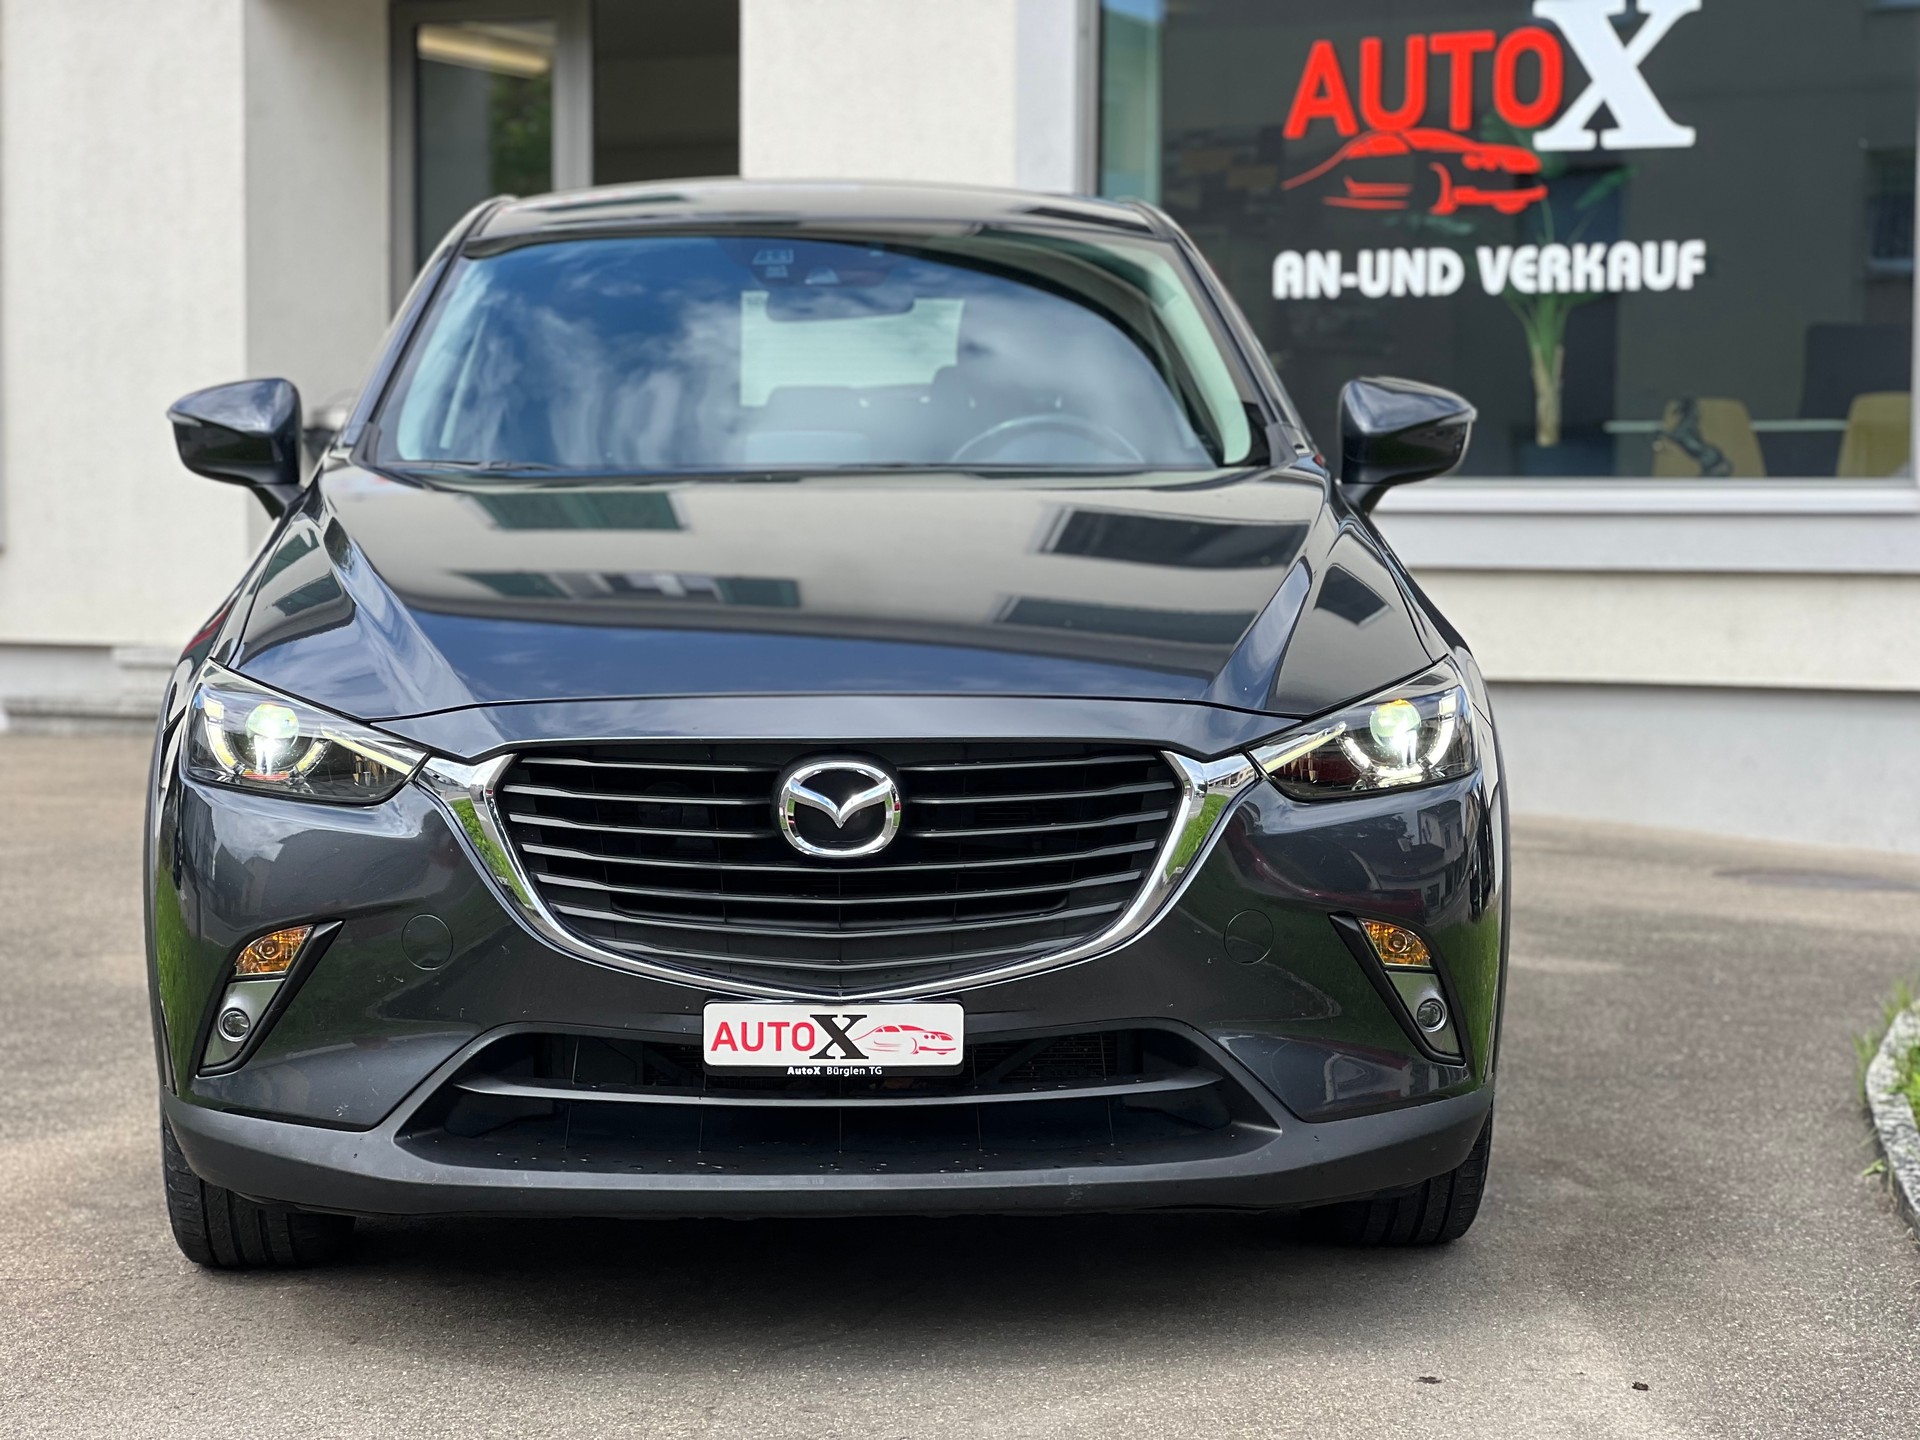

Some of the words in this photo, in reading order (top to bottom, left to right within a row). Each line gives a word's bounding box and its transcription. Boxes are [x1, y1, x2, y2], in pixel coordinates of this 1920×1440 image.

[1272, 247, 1465, 299] AN-UND
[1476, 239, 1706, 295] VERKAUF
[786, 1066, 821, 1075] AutoX
[826, 1066, 866, 1077] Bürglen
[868, 1066, 883, 1075] TG
